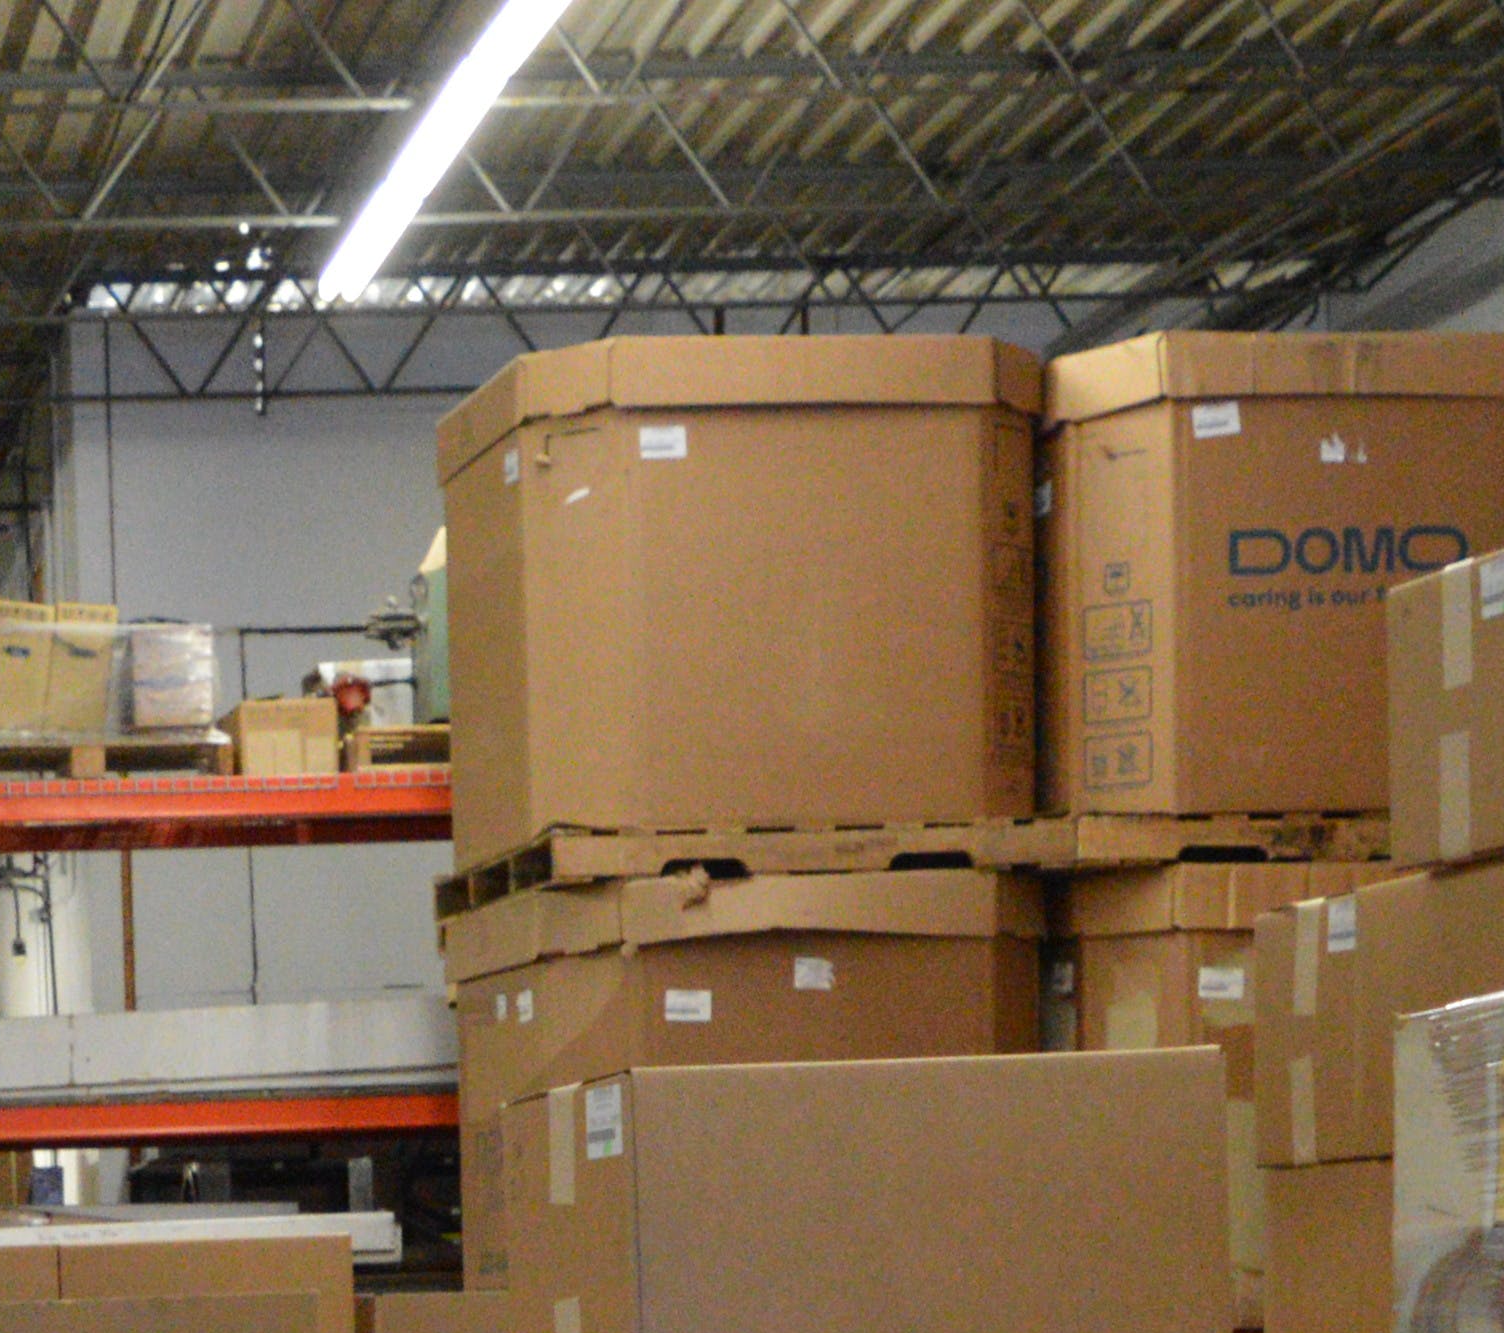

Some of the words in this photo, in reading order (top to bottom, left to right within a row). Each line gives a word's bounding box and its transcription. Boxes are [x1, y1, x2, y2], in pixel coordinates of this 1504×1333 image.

[1228, 524, 1470, 576] DOMO
[1228, 588, 1302, 611] caring
[1308, 587, 1326, 605] is
[1330, 589, 1374, 604] our
